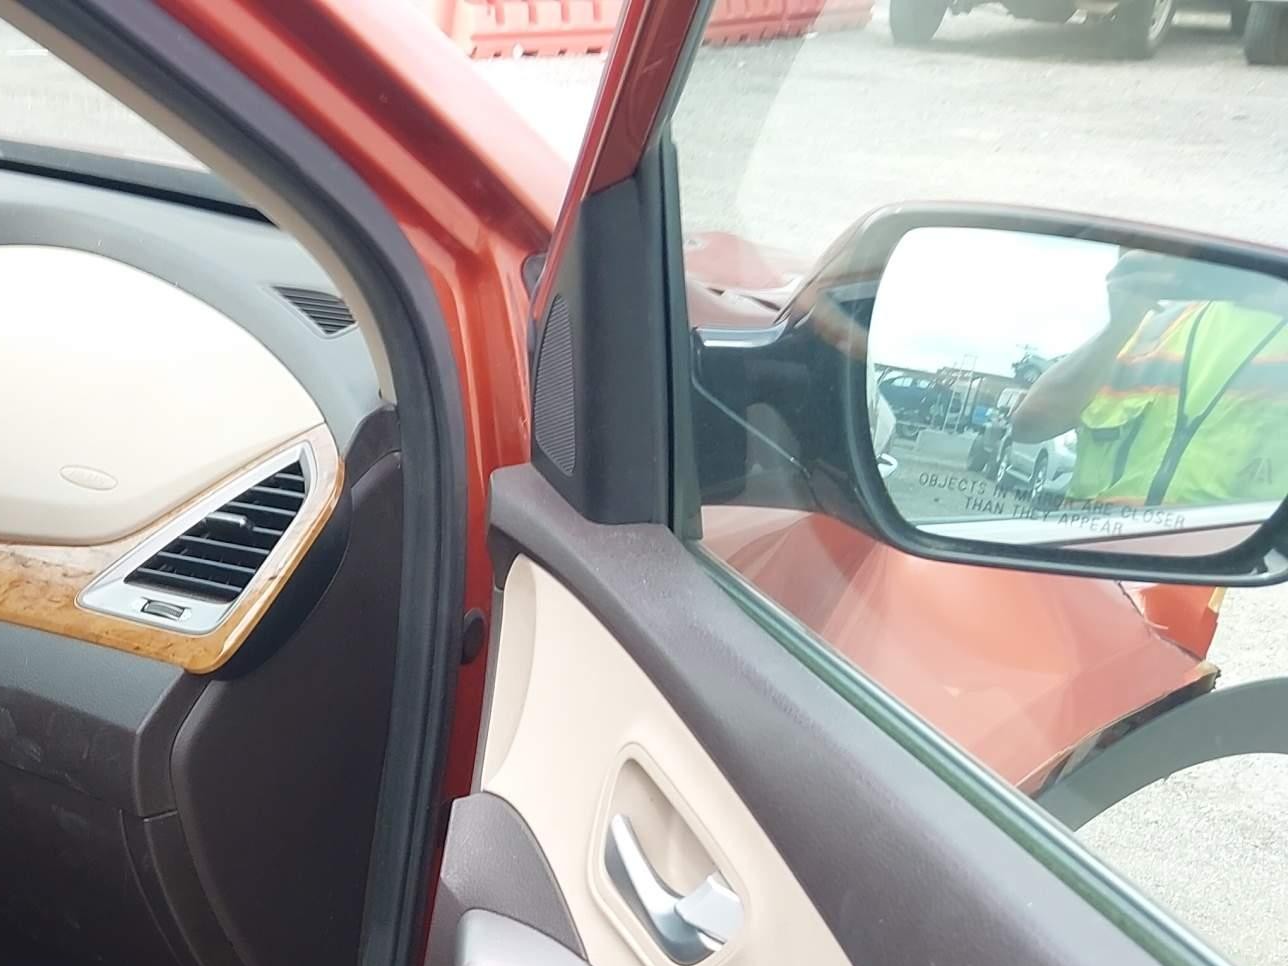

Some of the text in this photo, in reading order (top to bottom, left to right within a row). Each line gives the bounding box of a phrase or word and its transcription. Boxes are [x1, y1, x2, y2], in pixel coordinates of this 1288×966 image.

[918, 472, 987, 496] OBJECTS
[993, 484, 1009, 499] IN
[1080, 499, 1115, 517] ARE
[1120, 503, 1187, 529] CLOSER
[965, 496, 1124, 535] THAN THEY APPEAR
